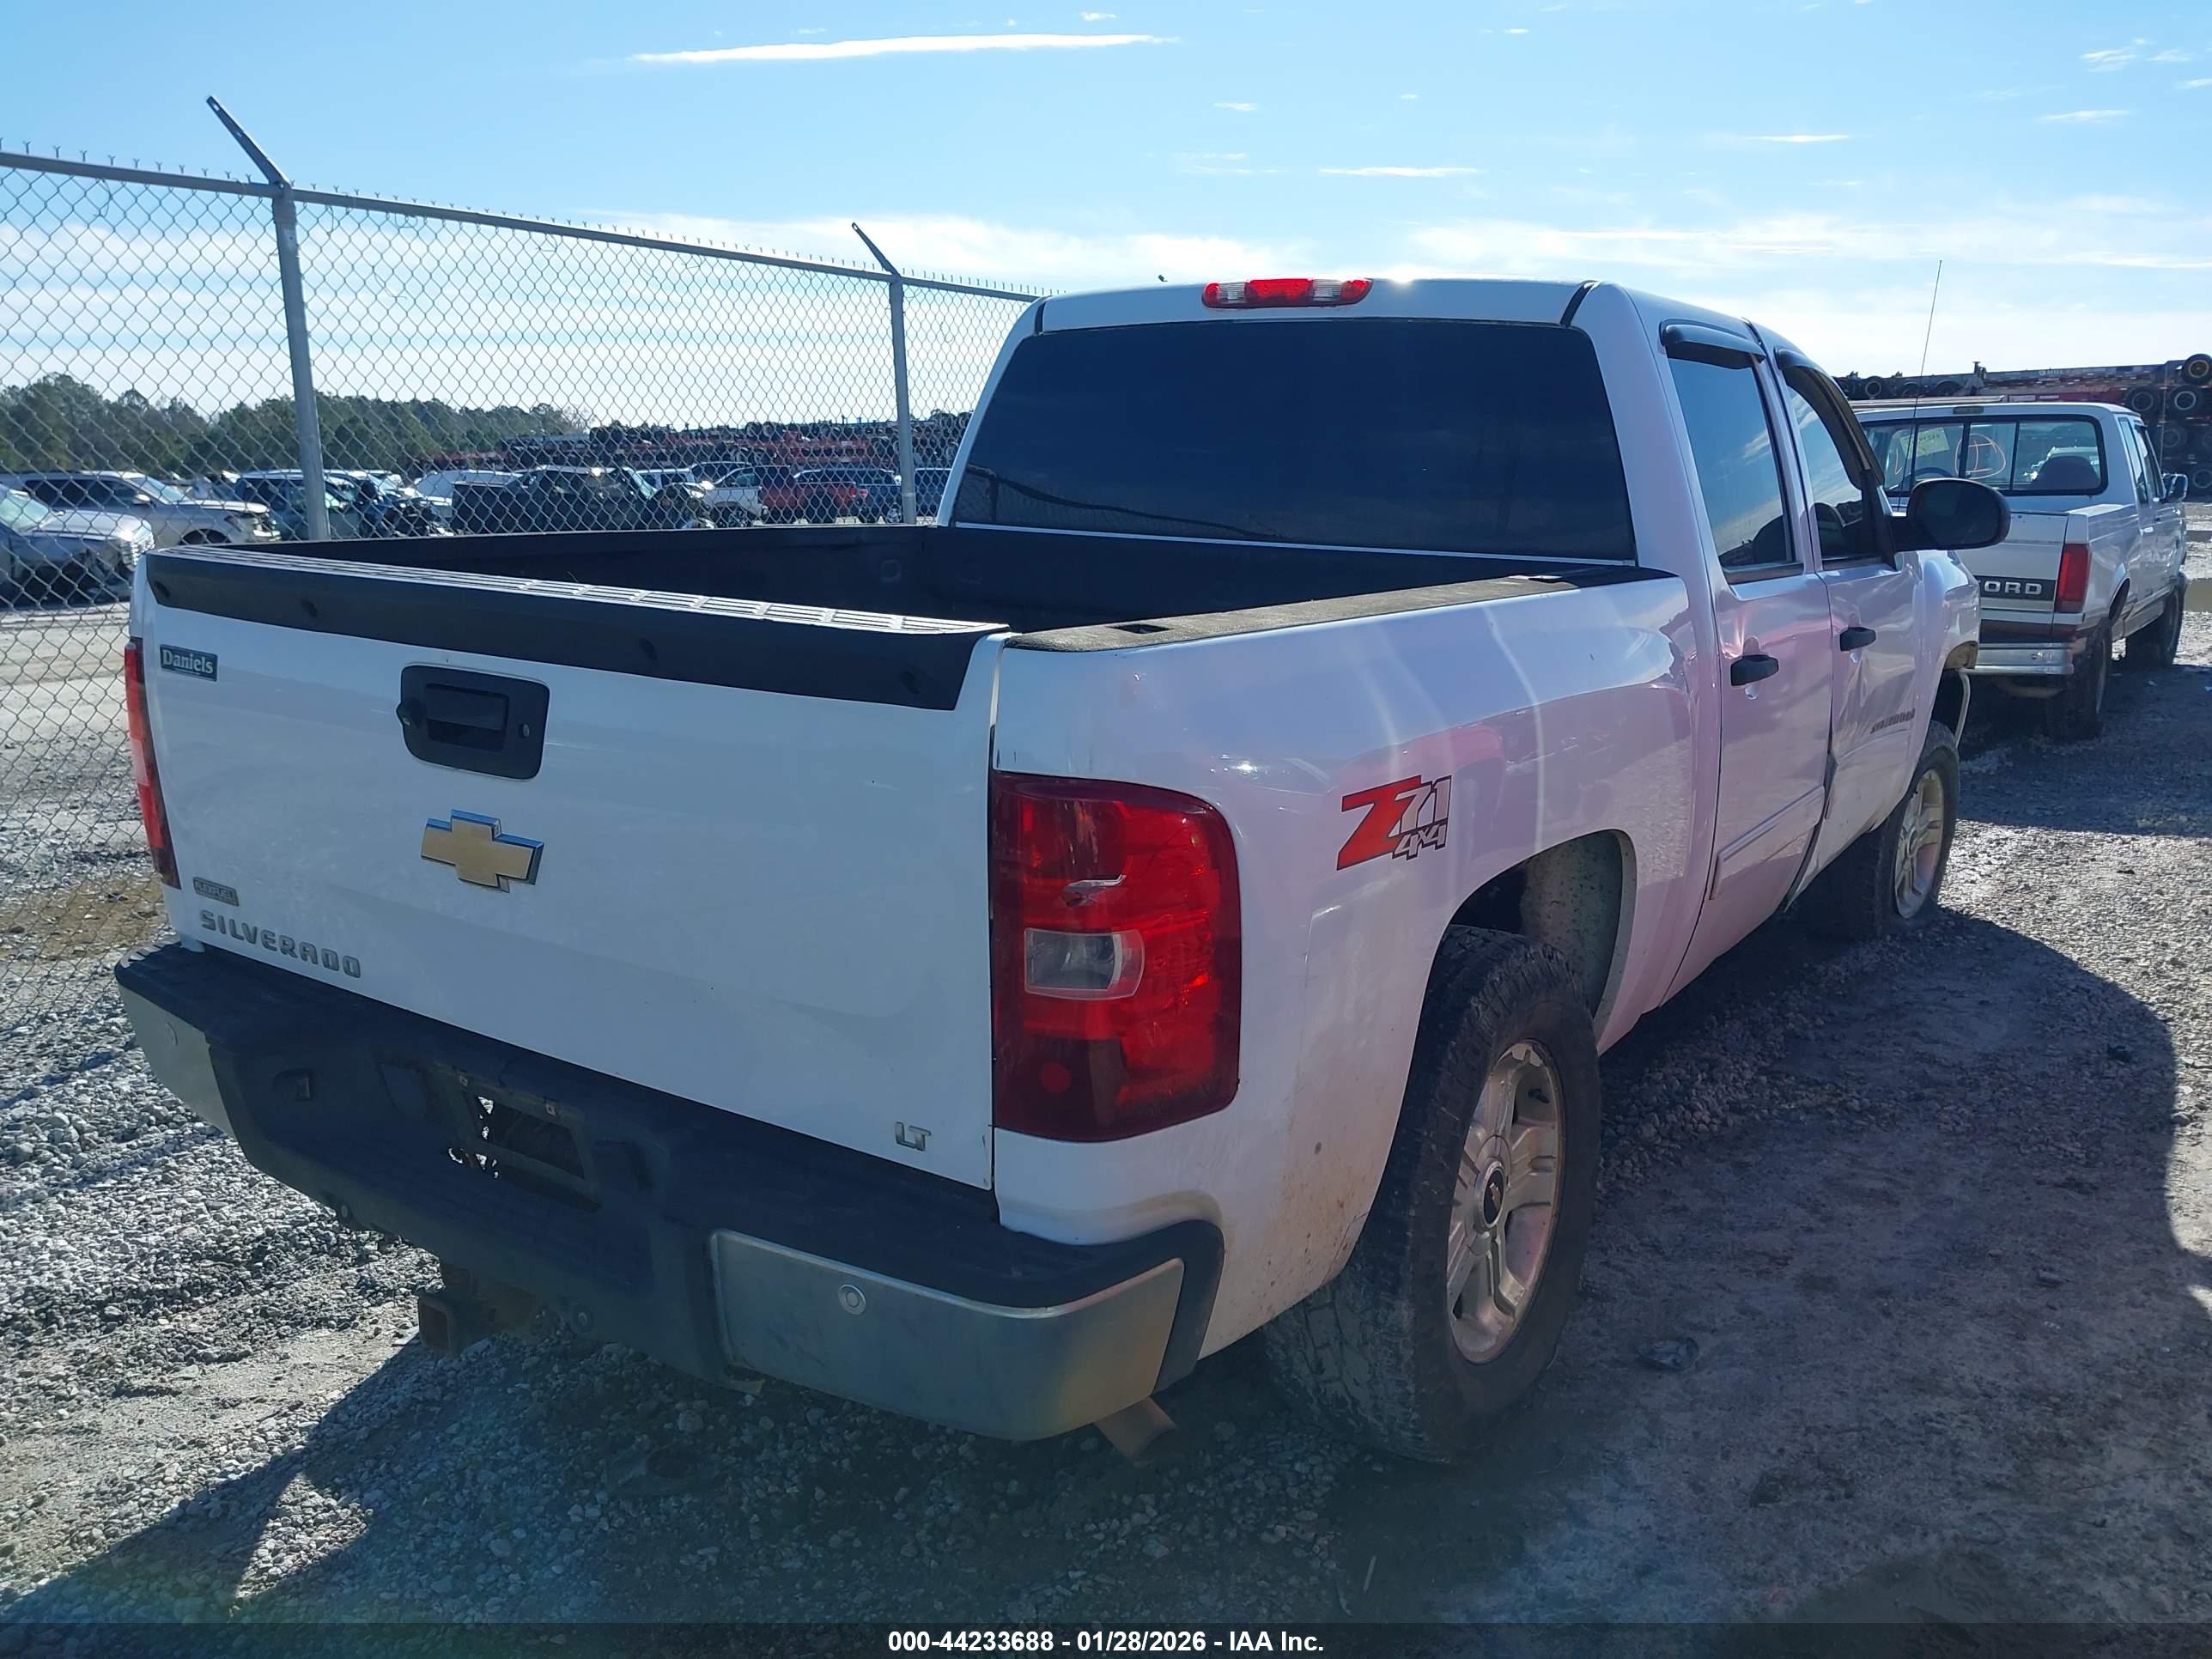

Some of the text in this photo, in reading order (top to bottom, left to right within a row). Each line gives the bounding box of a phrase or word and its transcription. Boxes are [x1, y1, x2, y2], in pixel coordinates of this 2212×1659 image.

[1978, 579, 2043, 595] ORD
[161, 649, 214, 674] Daniels
[1336, 775, 1452, 871] Z71
[200, 909, 361, 979] SILVERADO
[895, 1121, 932, 1152] LT
